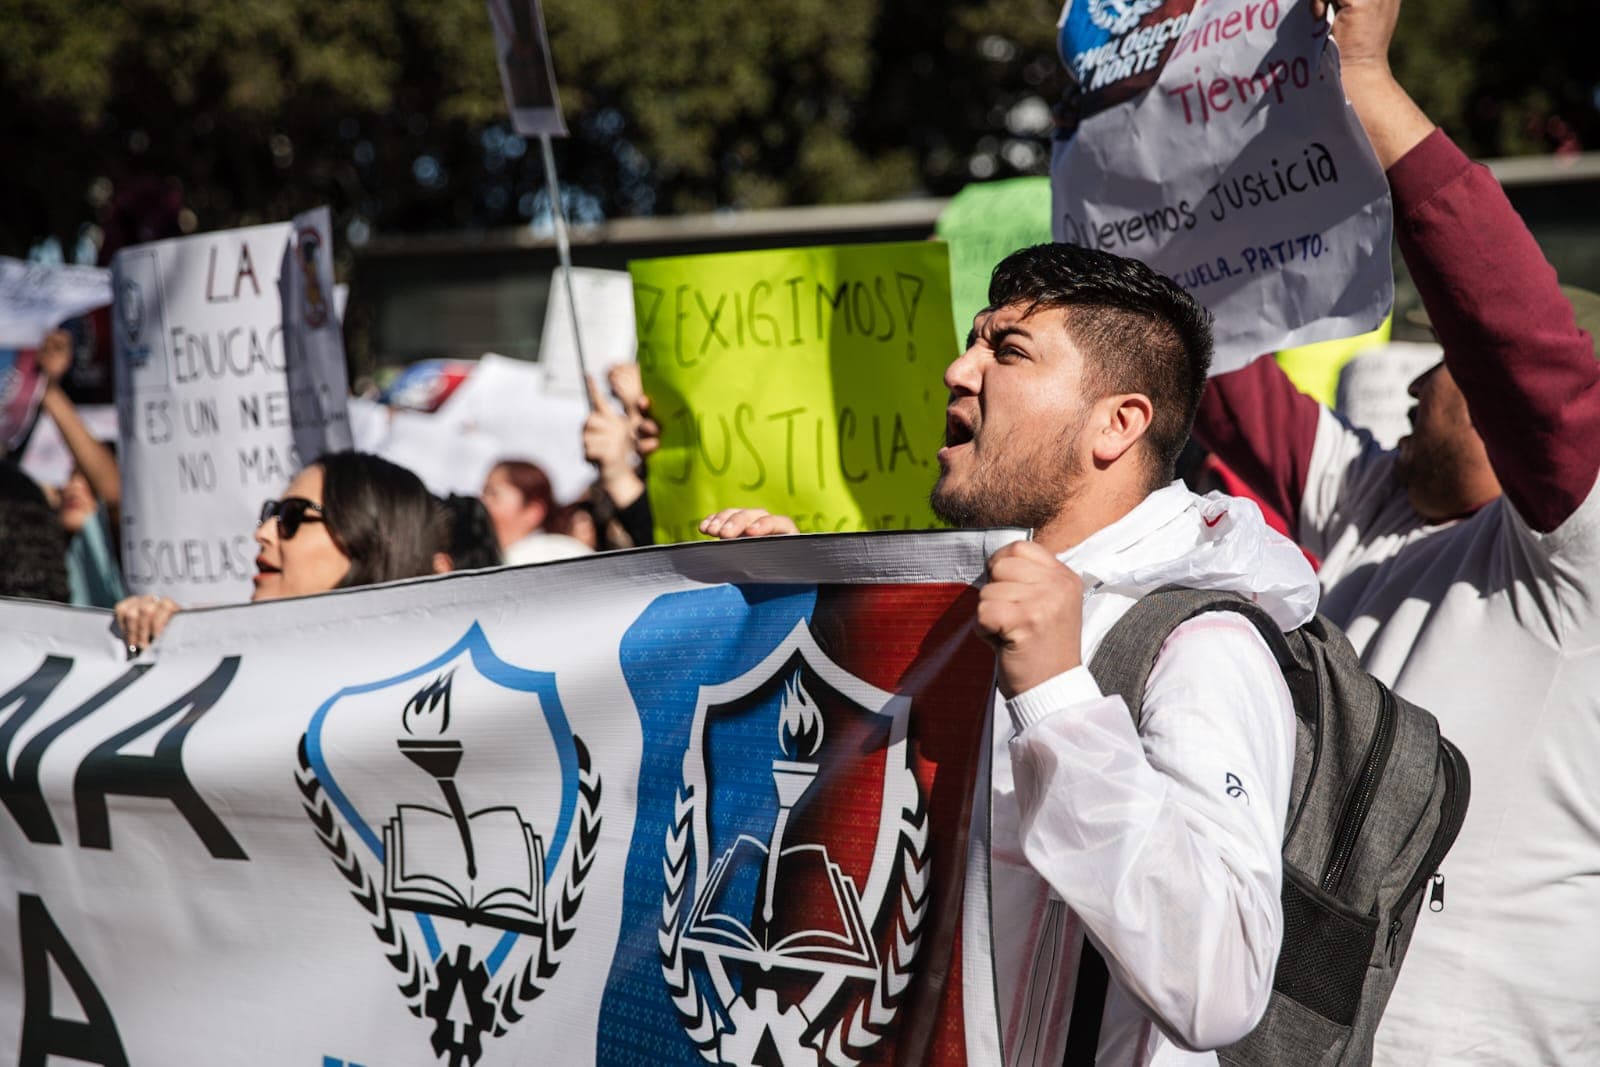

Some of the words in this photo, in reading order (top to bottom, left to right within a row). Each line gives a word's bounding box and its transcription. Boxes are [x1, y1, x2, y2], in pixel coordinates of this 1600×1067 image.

[1089, 43, 1166, 92] NORTE
[206, 243, 262, 303] LA
[183, 396, 220, 439] UN
[178, 452, 217, 494] NO
[18, 890, 131, 1067] A
